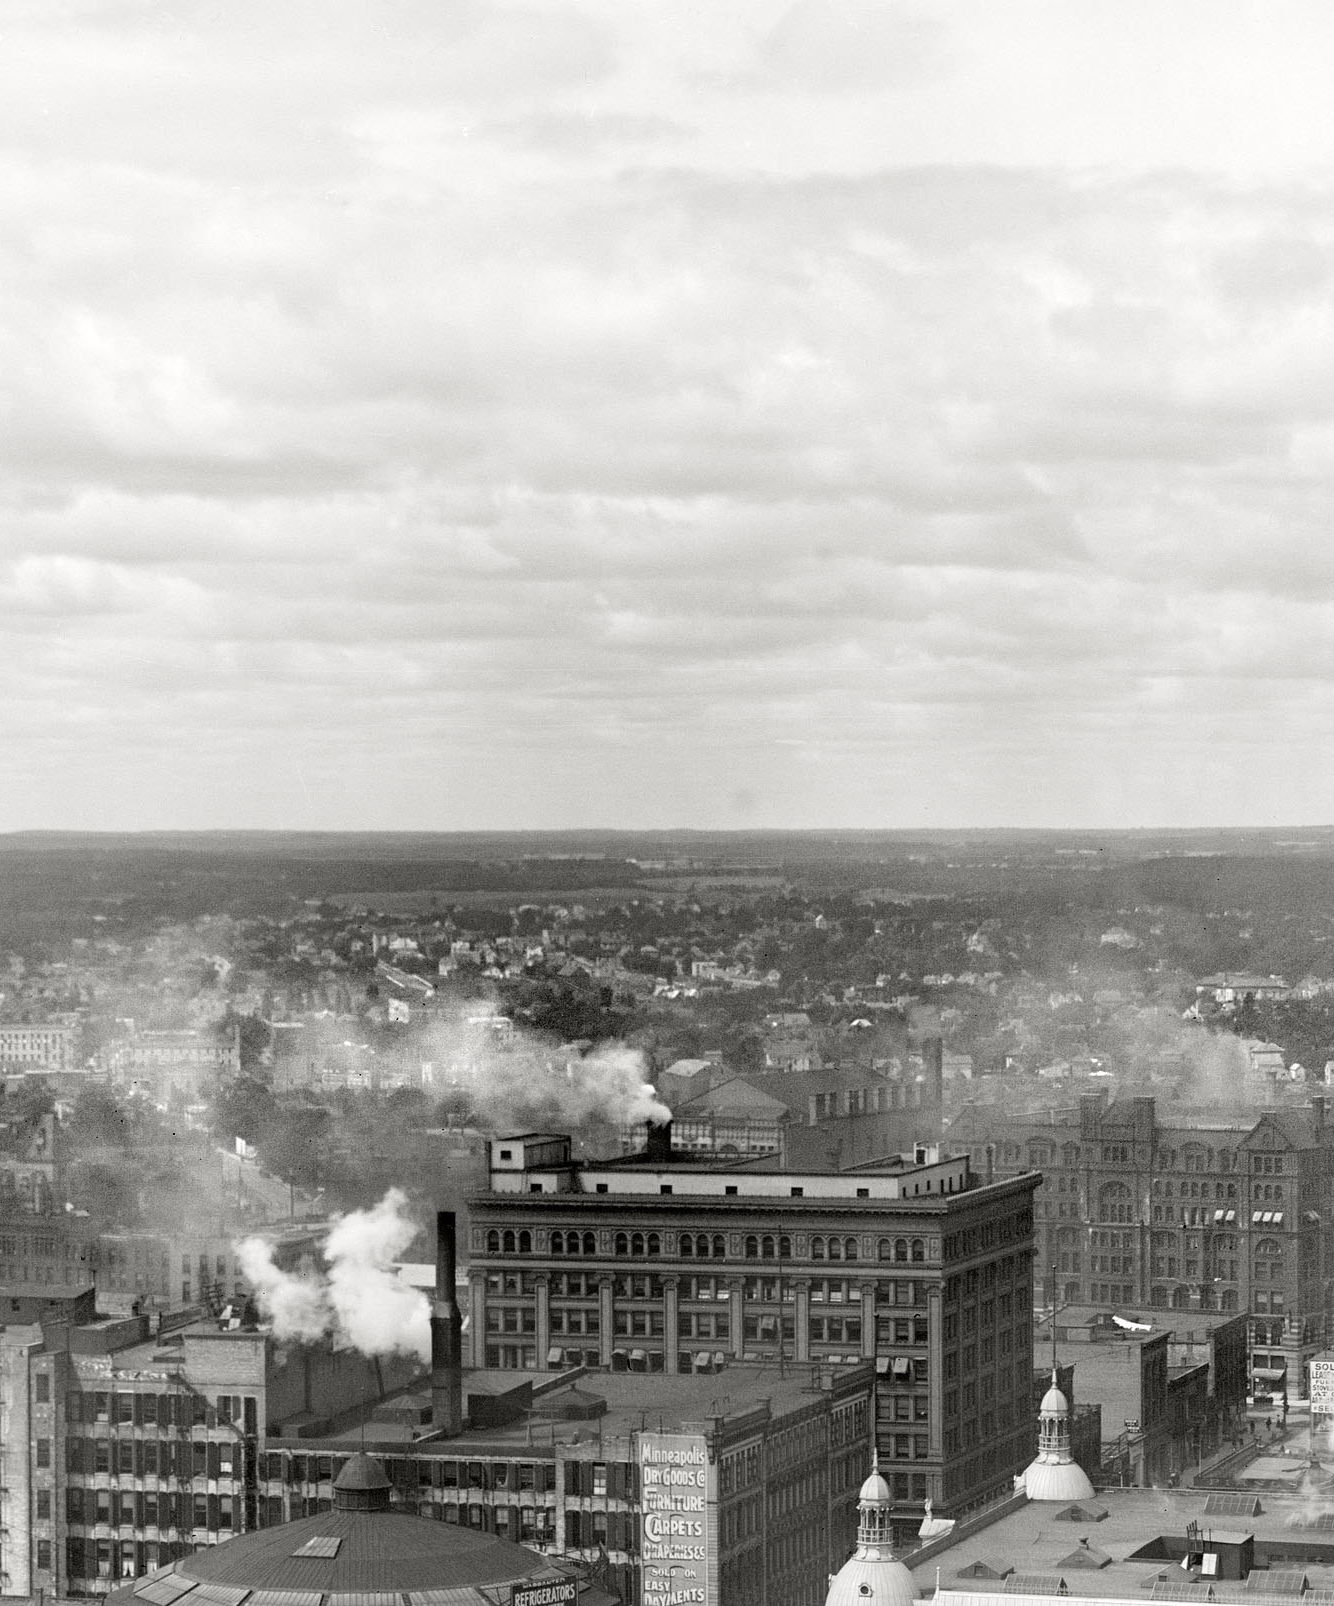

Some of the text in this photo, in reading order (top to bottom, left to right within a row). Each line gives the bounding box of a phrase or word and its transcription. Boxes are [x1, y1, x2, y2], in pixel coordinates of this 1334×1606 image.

[642, 1443, 704, 1465] Minneapolis
[663, 1468, 695, 1486] GOODS
[643, 1487, 704, 1513] FURNITURE
[645, 1513, 702, 1542] CARPETS
[651, 1568, 696, 1578] SOLD ON
[645, 1581, 670, 1592] EASY
